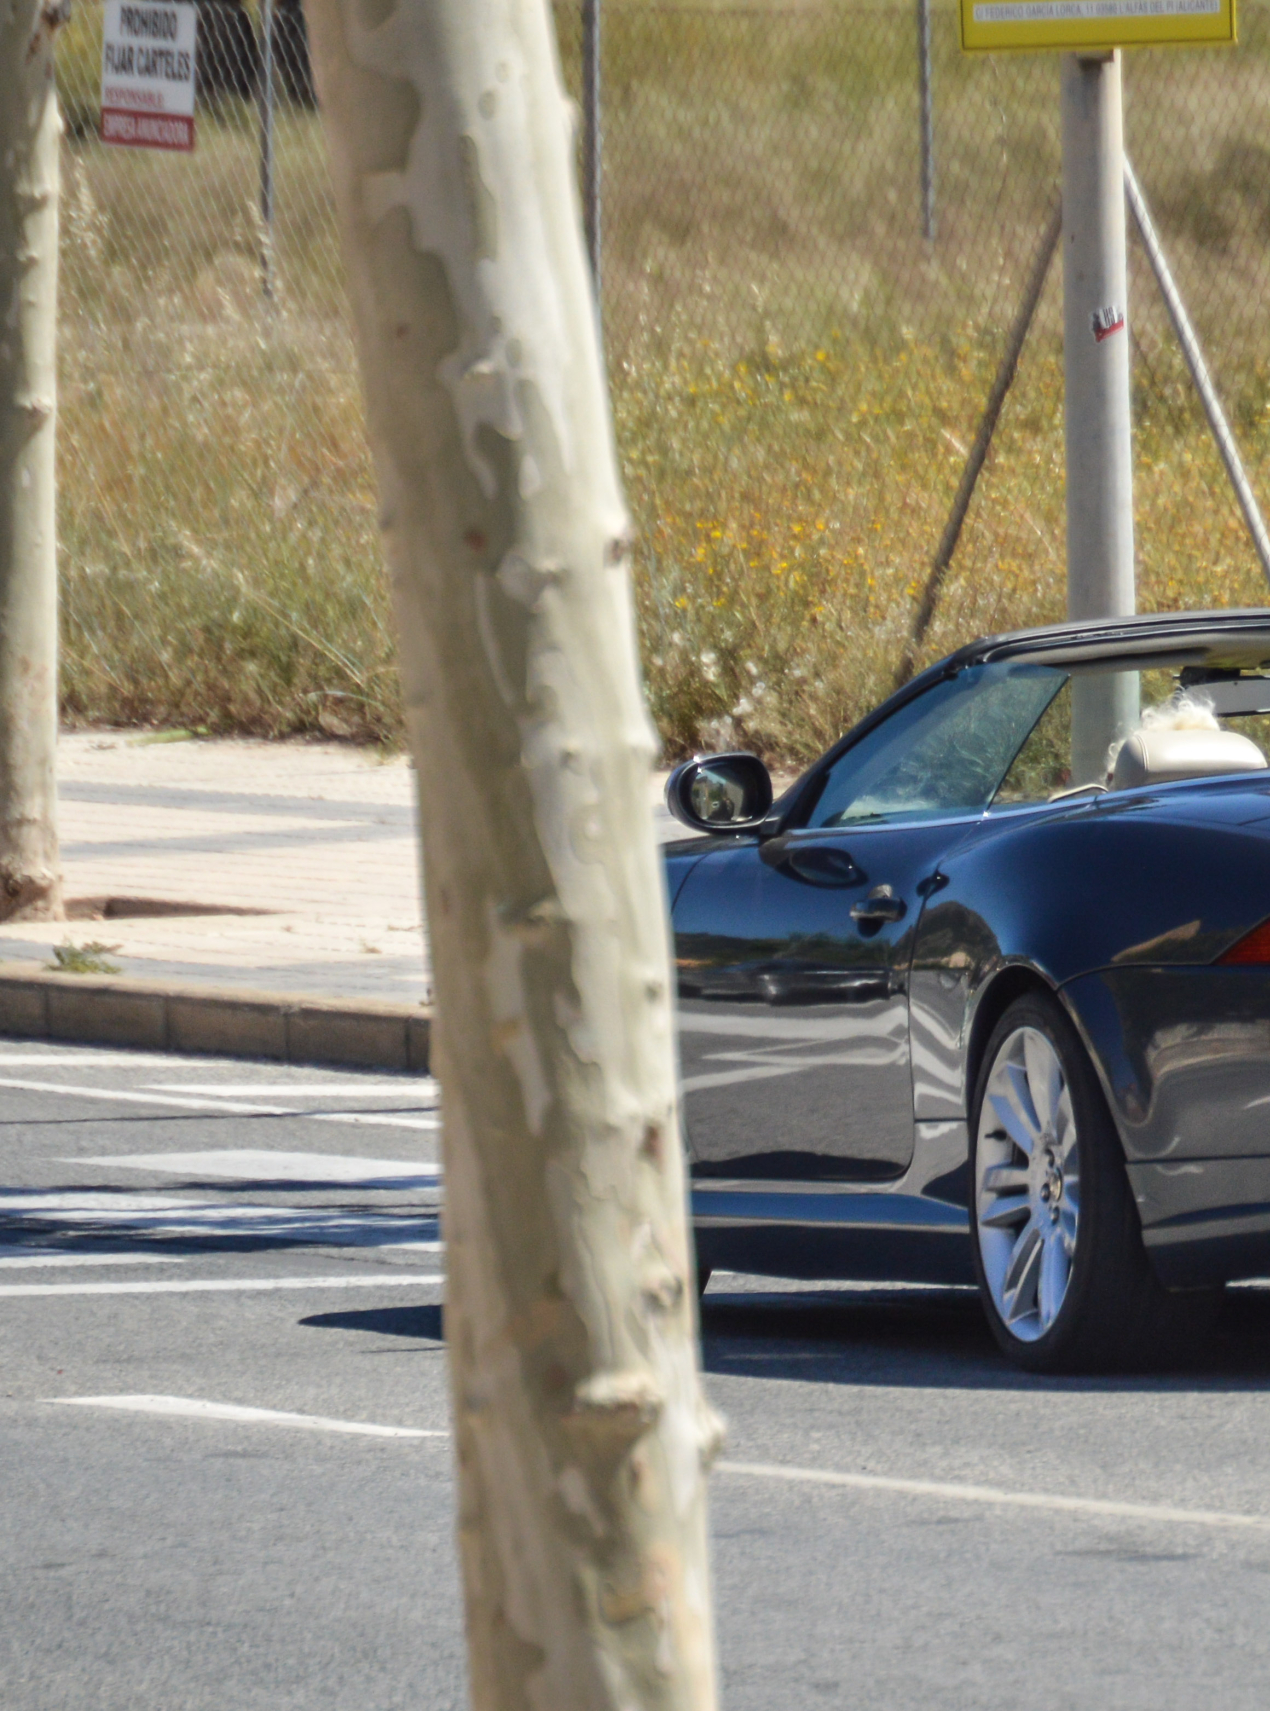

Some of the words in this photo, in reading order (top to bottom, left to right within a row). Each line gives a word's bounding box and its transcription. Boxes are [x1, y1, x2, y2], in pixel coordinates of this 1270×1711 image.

[120, 5, 178, 41] PROHIBIDO
[985, 4, 1023, 20] FEDERICO
[104, 42, 134, 76] FIJAR
[136, 45, 190, 83] CARTELES
